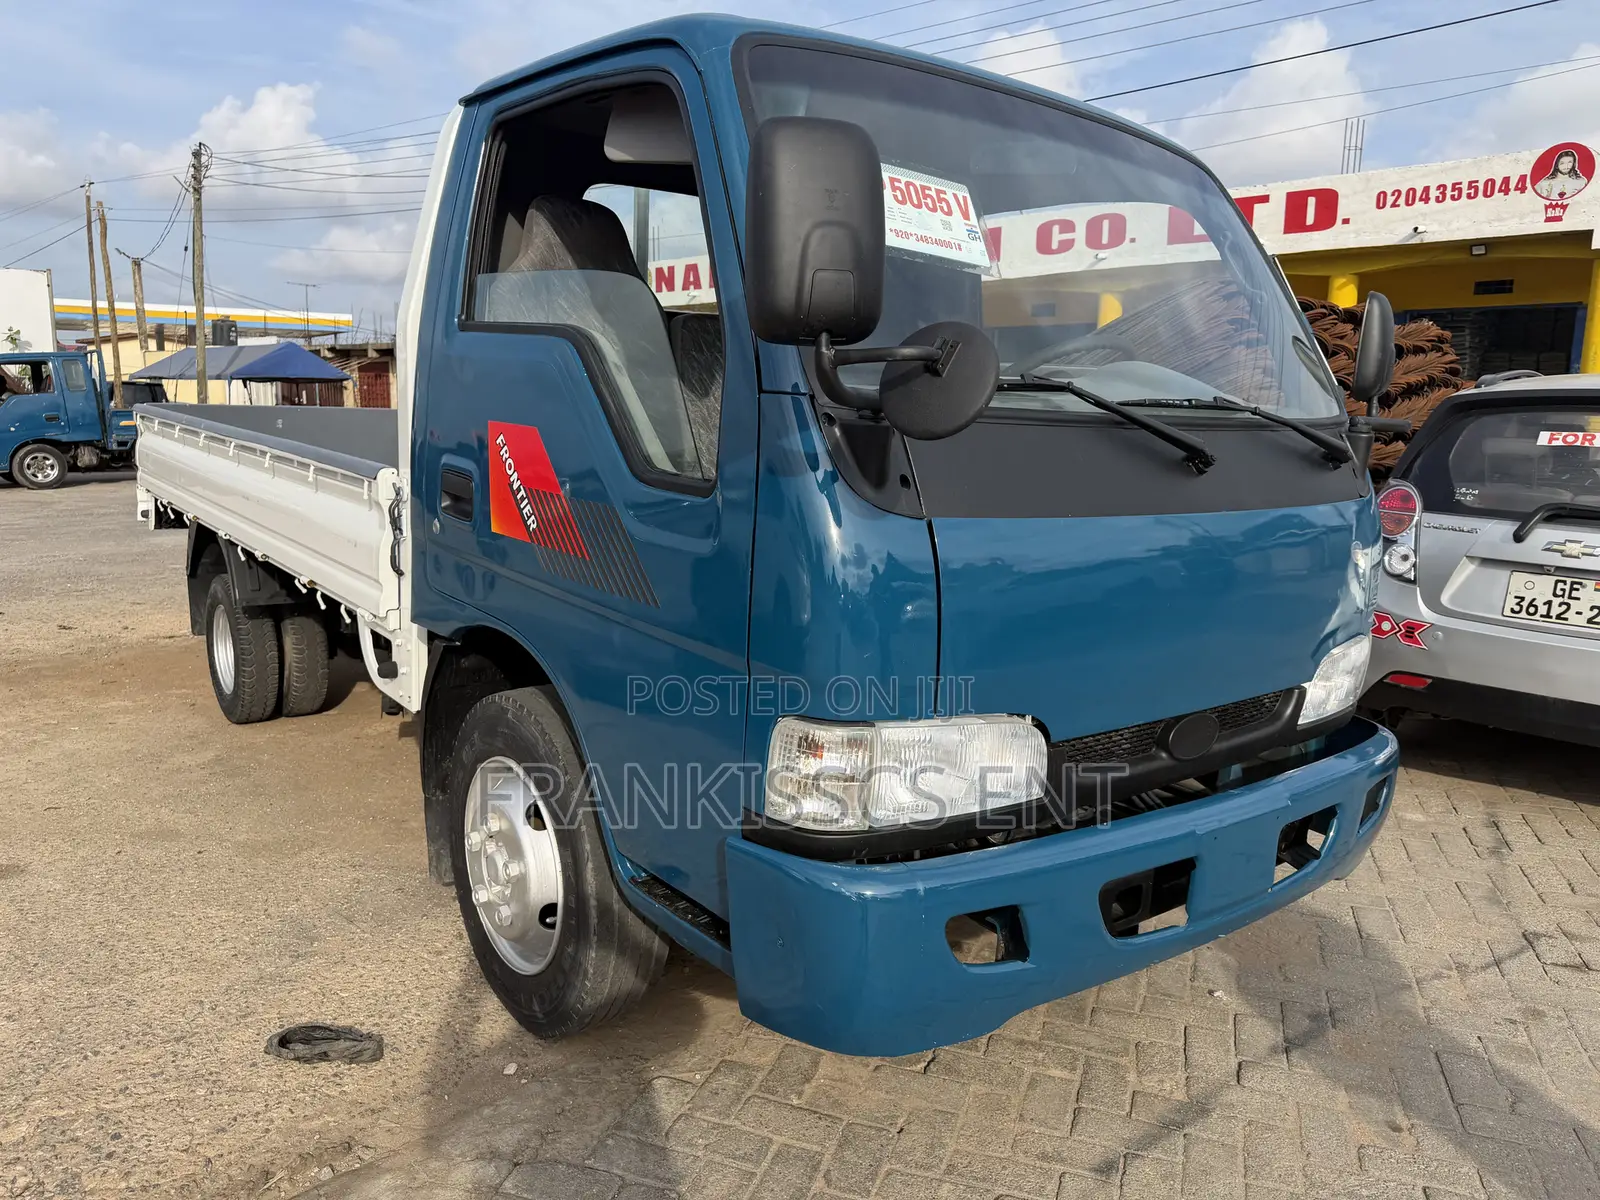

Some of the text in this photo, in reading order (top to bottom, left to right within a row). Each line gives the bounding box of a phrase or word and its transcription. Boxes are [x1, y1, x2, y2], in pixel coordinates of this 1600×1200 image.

[888, 176, 953, 217] 5055
[952, 192, 971, 222] V
[1375, 174, 1528, 210] 0204355044
[655, 263, 715, 293] NA
[1036, 213, 1136, 256] CO.
[968, 232, 982, 243] GH
[1547, 432, 1597, 446] FOR
[495, 432, 537, 532] FRONTIER
[1552, 579, 1583, 601] GE
